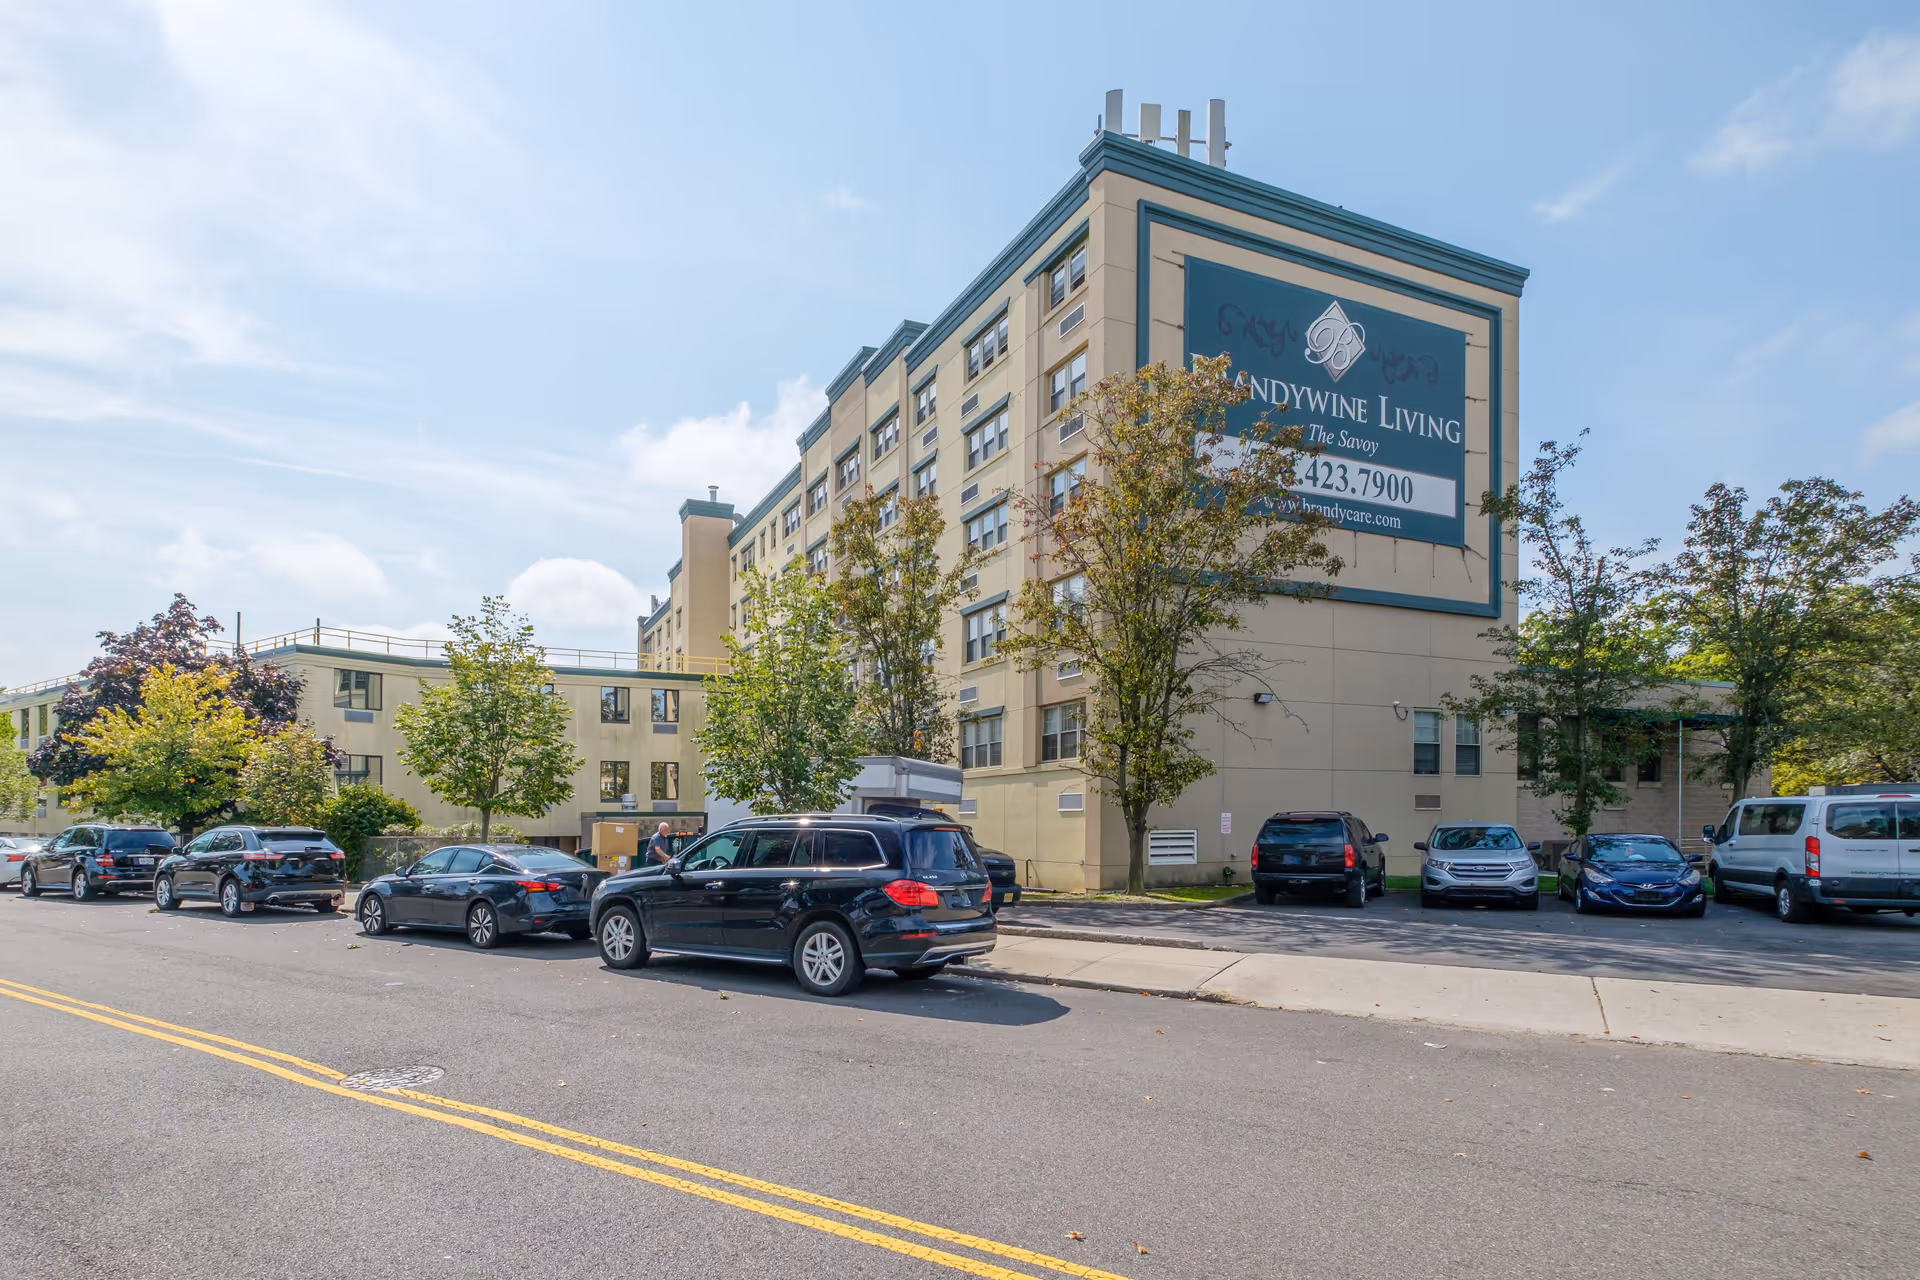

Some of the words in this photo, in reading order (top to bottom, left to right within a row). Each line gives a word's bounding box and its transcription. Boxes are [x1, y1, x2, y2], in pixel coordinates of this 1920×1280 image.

[1190, 352, 1367, 424] ANDYWINE
[1309, 423, 1335, 445] The
[1338, 429, 1379, 457] Savoy
[1250, 448, 1413, 504] .423.7900
